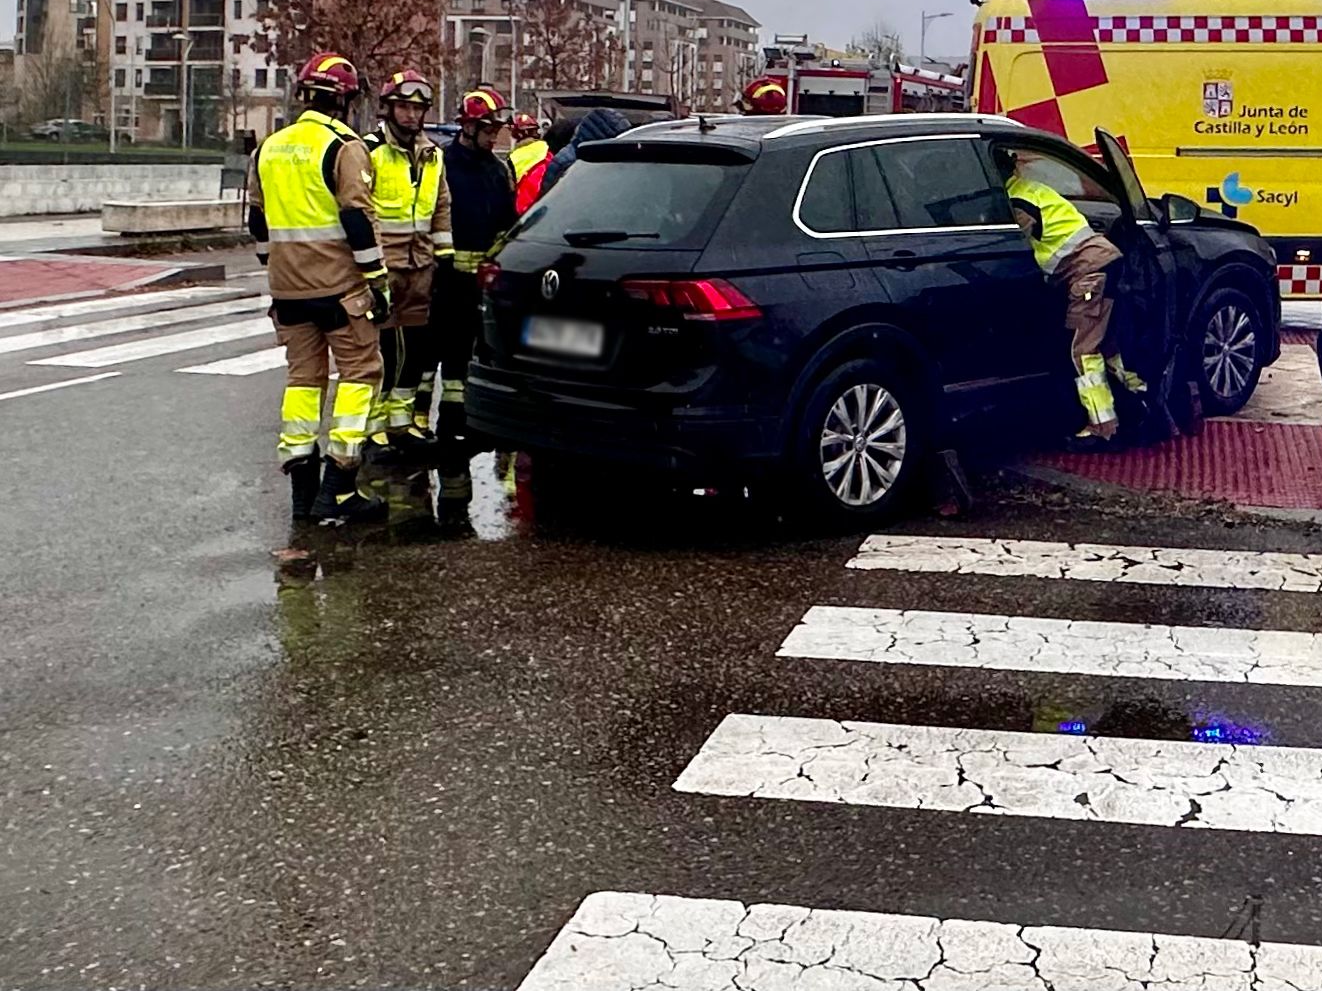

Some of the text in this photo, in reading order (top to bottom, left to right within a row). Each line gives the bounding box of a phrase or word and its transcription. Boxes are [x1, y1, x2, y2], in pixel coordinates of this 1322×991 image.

[1239, 105, 1309, 118] Junta de
[1194, 120, 1309, 138] Castilla y León
[1257, 190, 1298, 207] Sacyl
